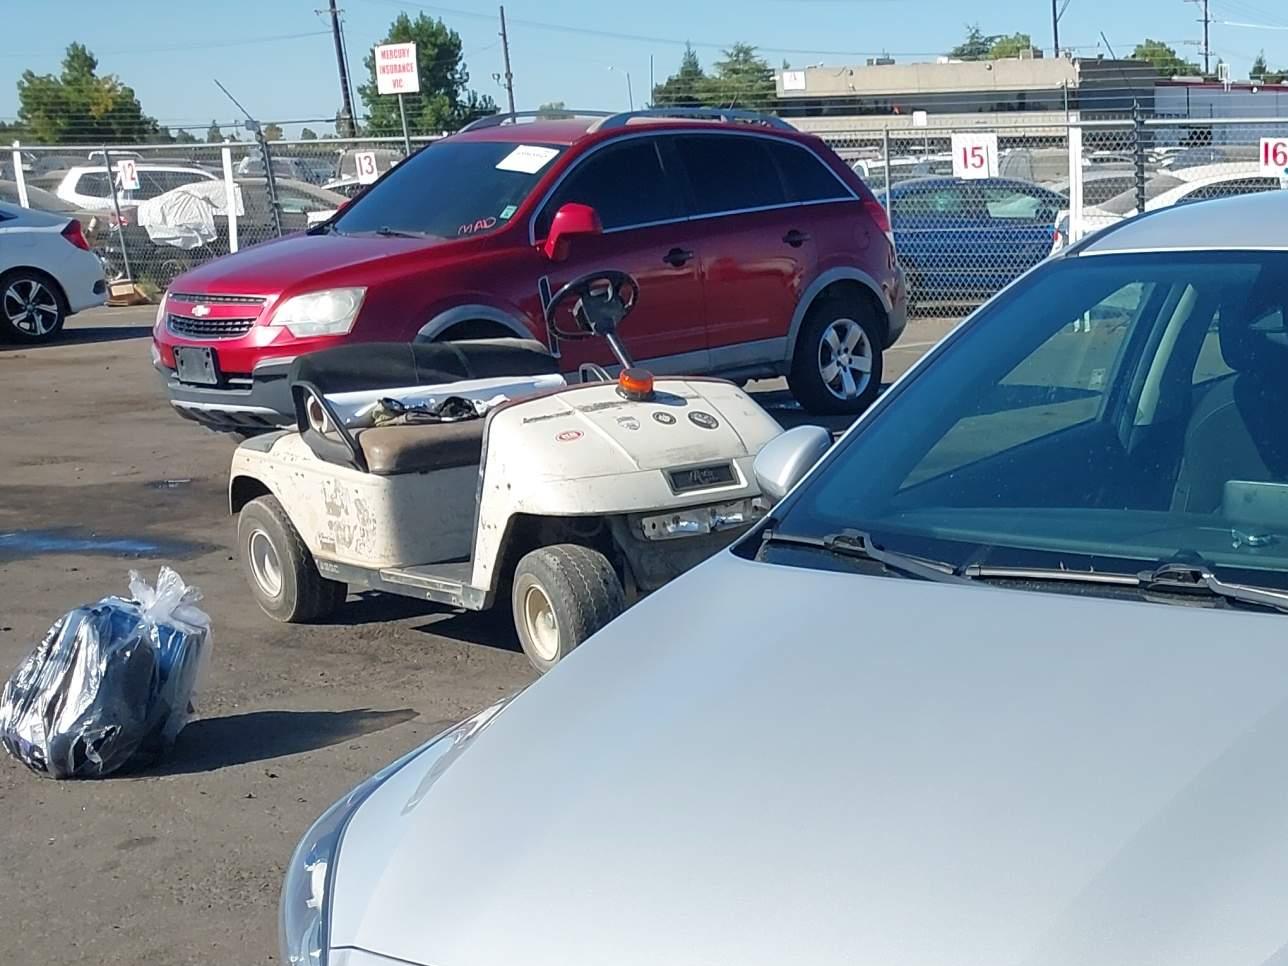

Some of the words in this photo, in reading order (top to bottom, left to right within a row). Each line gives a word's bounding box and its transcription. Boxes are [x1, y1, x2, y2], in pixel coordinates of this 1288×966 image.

[381, 48, 409, 60] MERCURY
[379, 62, 414, 75] INSURANCE
[963, 146, 984, 169] 15
[1264, 142, 1288, 167] 16
[122, 162, 136, 181] 12
[358, 155, 374, 176] 13
